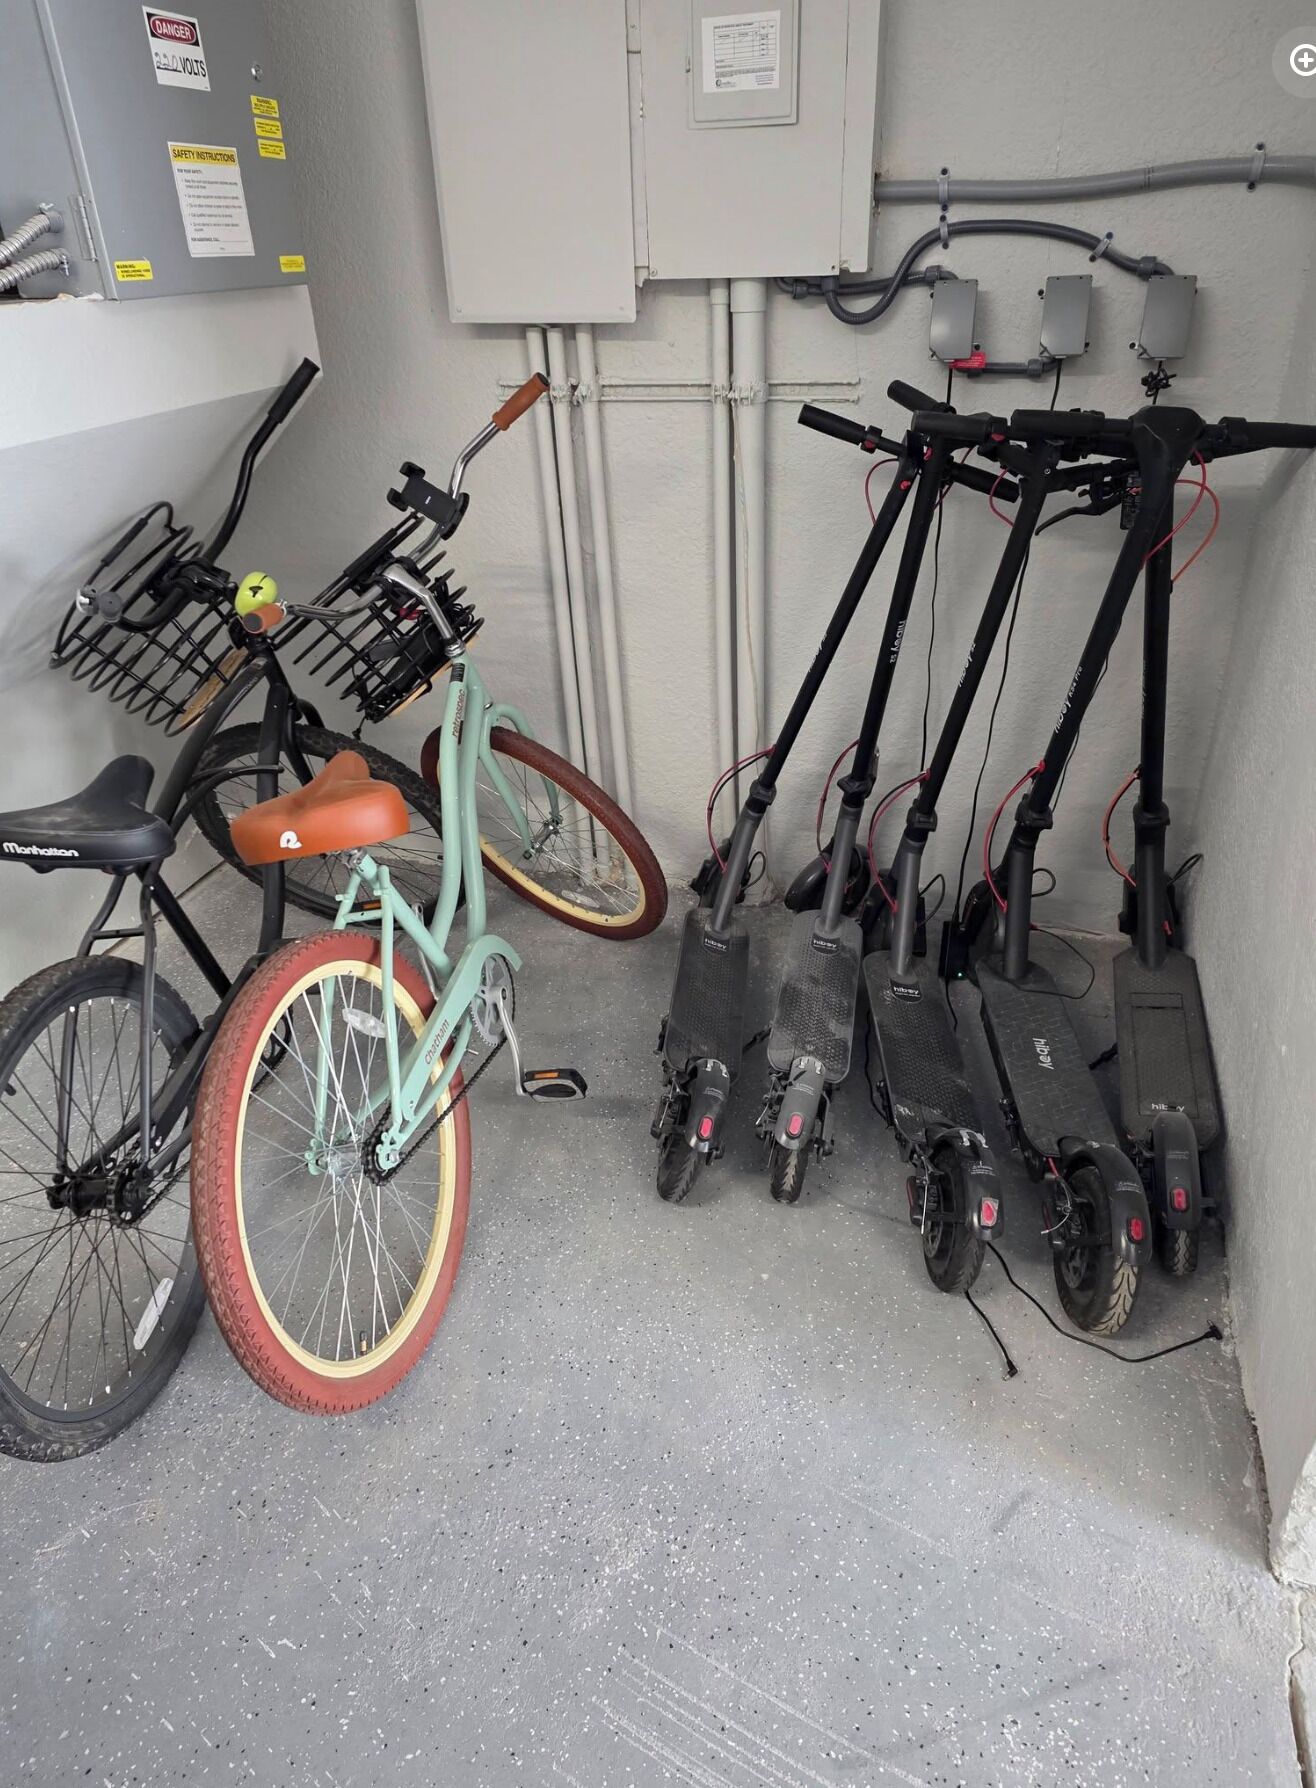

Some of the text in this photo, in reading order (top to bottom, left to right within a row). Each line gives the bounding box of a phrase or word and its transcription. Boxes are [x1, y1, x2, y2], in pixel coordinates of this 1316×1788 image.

[155, 19, 192, 40] DANGER
[179, 56, 207, 78] VOLTS
[172, 149, 236, 163] SAFETY INSTRUCTIONS
[452, 688, 466, 738] retrospec
[2, 842, 80, 857] Manhattan
